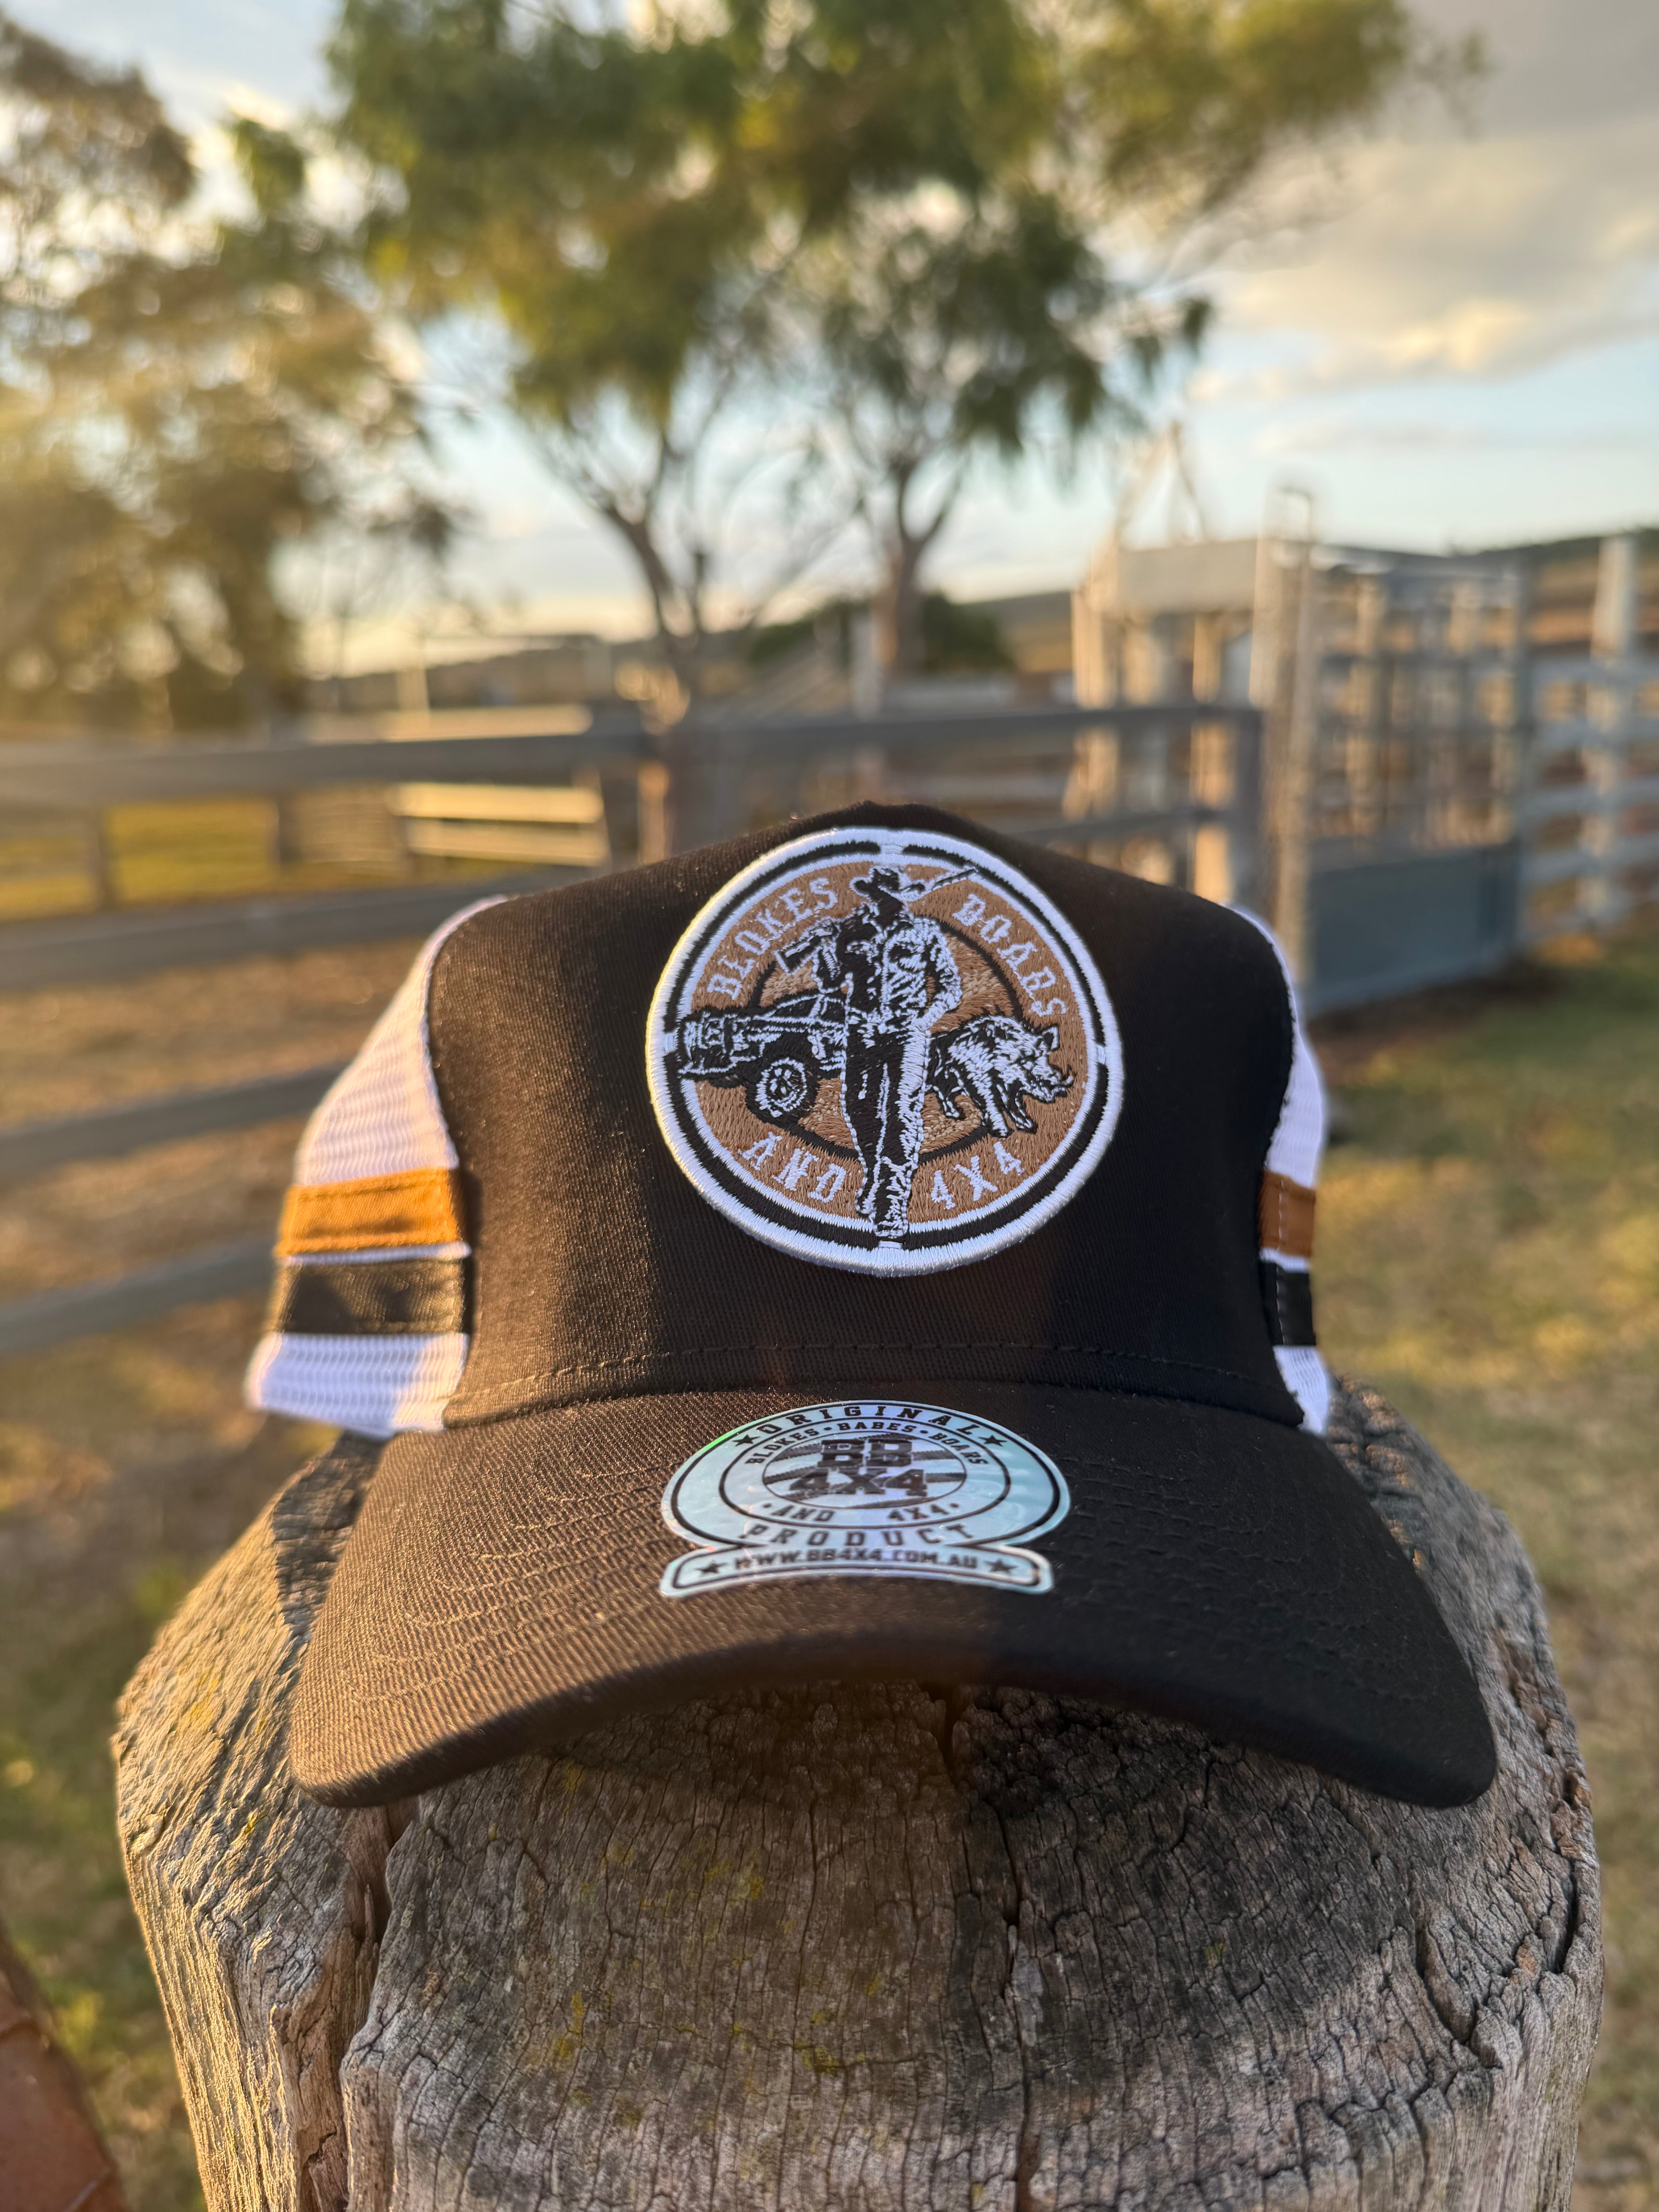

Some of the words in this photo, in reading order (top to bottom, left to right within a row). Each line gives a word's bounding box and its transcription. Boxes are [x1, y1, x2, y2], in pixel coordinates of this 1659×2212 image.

[707, 878, 837, 1000] BLOKES
[953, 894, 1067, 1017] BOARS
[737, 1131, 847, 1204] AND
[930, 1141, 1022, 1210] 4X4
[757, 1404, 980, 1434] ORIGINAL
[745, 1427, 820, 1465] BLOKES
[836, 1422, 917, 1433] BABES
[931, 1432, 989, 1466] BOARS
[817, 1438, 914, 1468] BB
[789, 1467, 928, 1496] 4X4
[771, 1505, 836, 1522] AND
[887, 1504, 949, 1522] 4X4
[738, 1523, 974, 1547] PRODUCT
